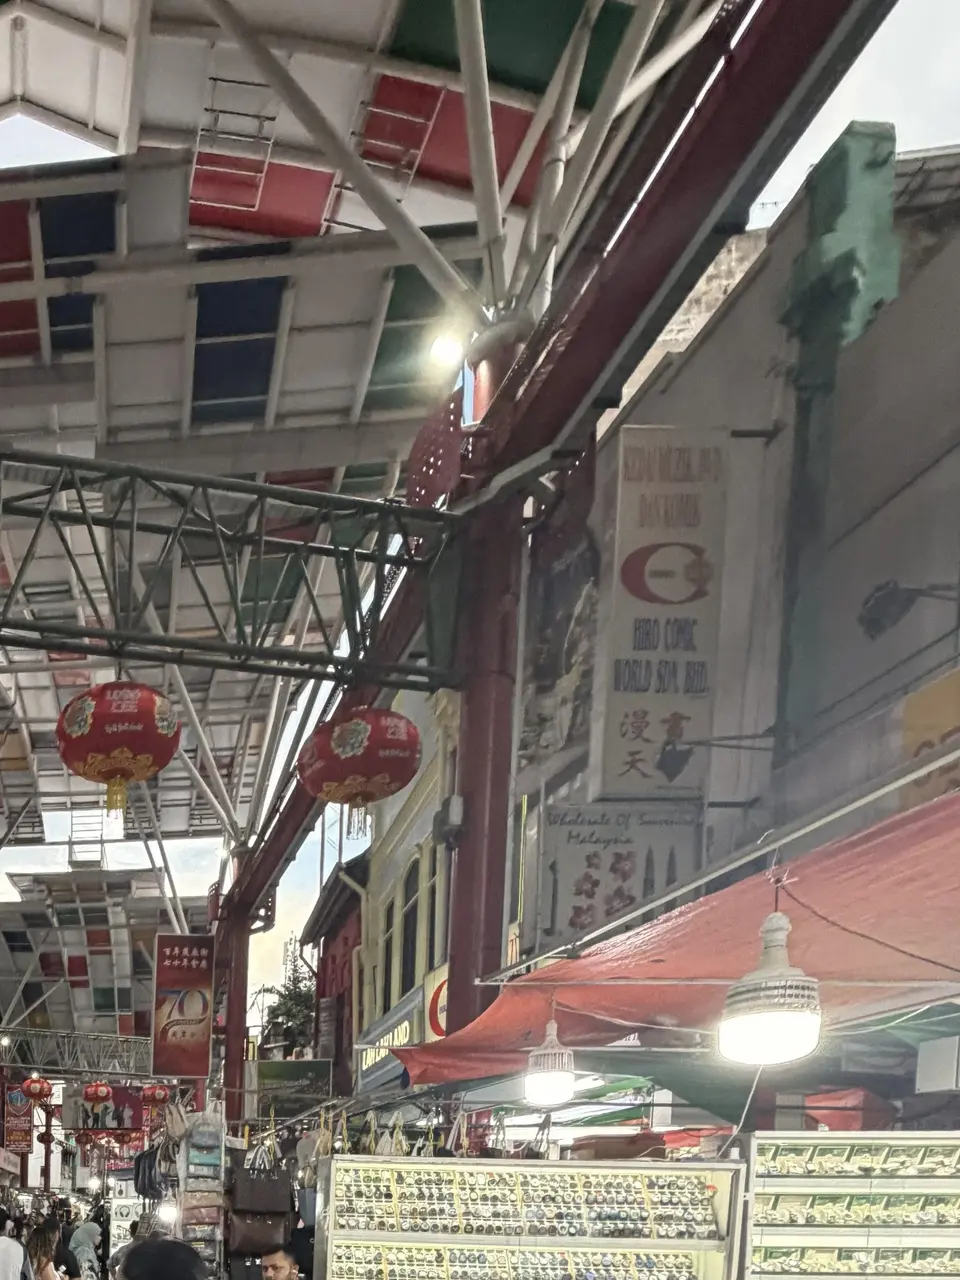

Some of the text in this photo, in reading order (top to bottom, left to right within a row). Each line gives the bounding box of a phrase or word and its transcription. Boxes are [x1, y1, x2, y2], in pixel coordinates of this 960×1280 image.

[634, 617, 659, 650] HERO
[614, 659, 652, 692] WORLD
[616, 813, 631, 831] Of
[567, 830, 635, 850] Malaysia
[159, 989, 209, 1021] 70
